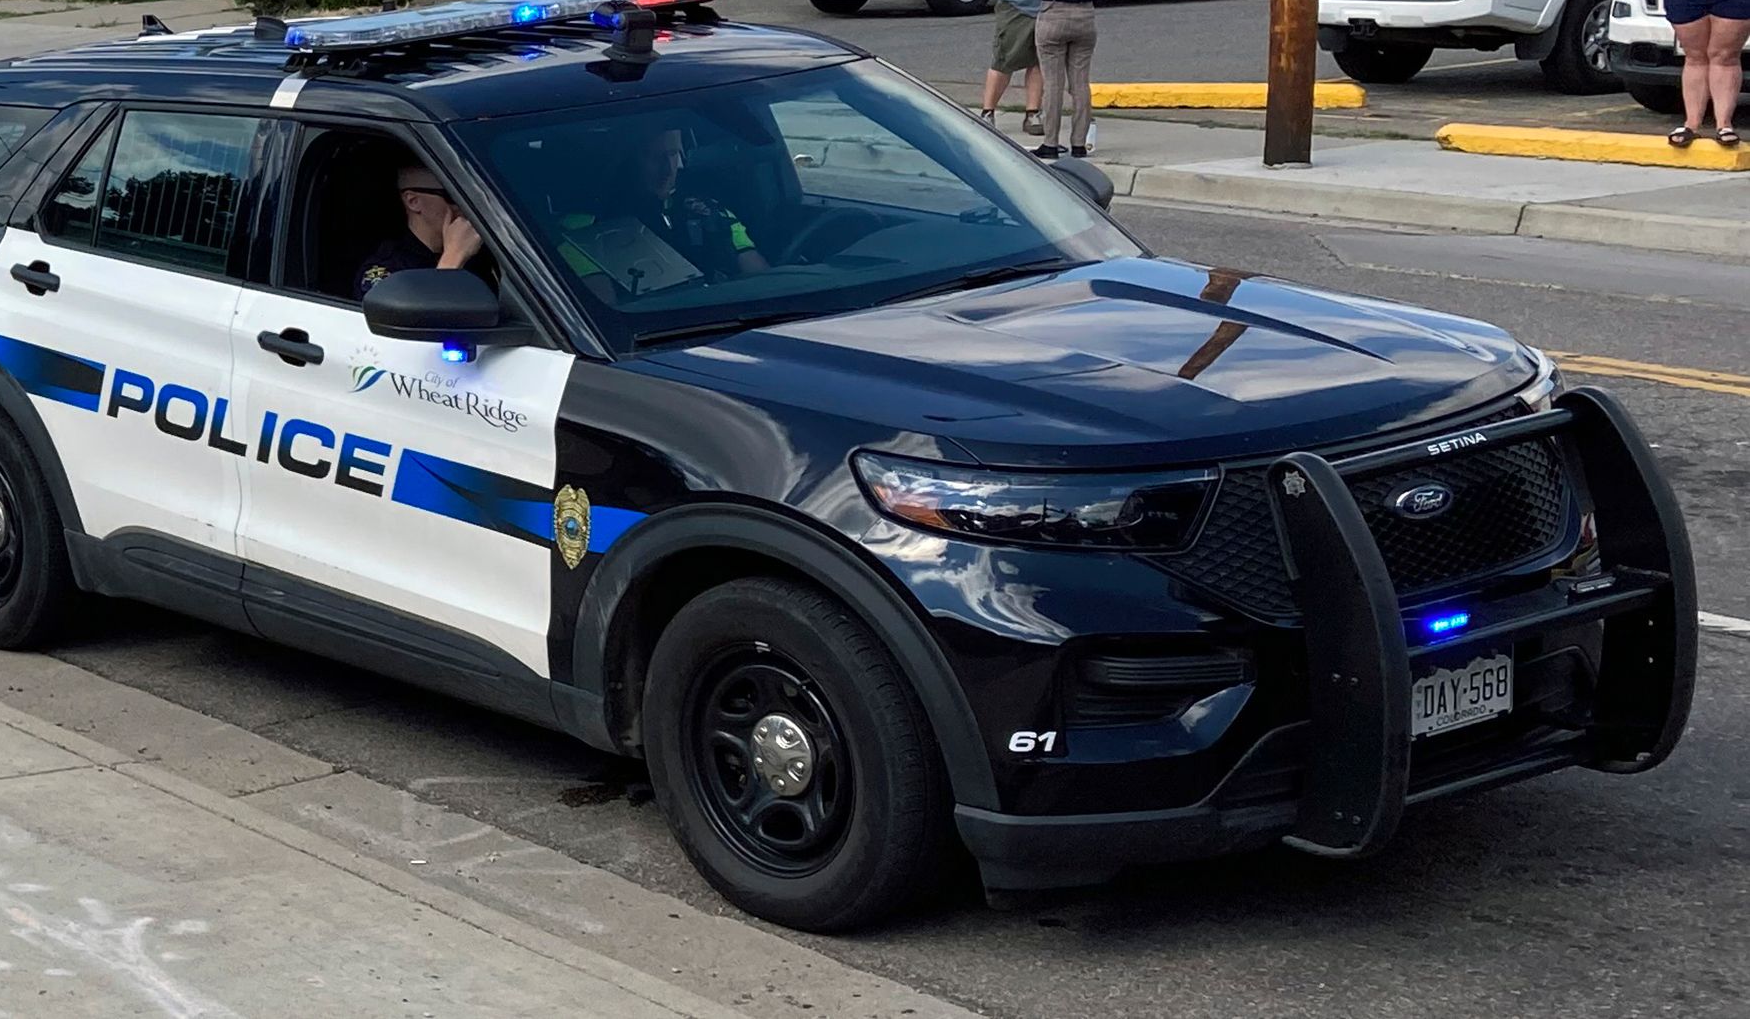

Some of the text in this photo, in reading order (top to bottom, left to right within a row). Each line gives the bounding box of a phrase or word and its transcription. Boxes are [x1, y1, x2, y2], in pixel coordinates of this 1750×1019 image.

[425, 370, 458, 388] City of
[389, 372, 528, 432] Wheat Ridge
[106, 368, 392, 498] POLICE
[1427, 432, 1487, 456] SETINA
[1413, 491, 1443, 513] Ford
[1008, 731, 1057, 752] 61
